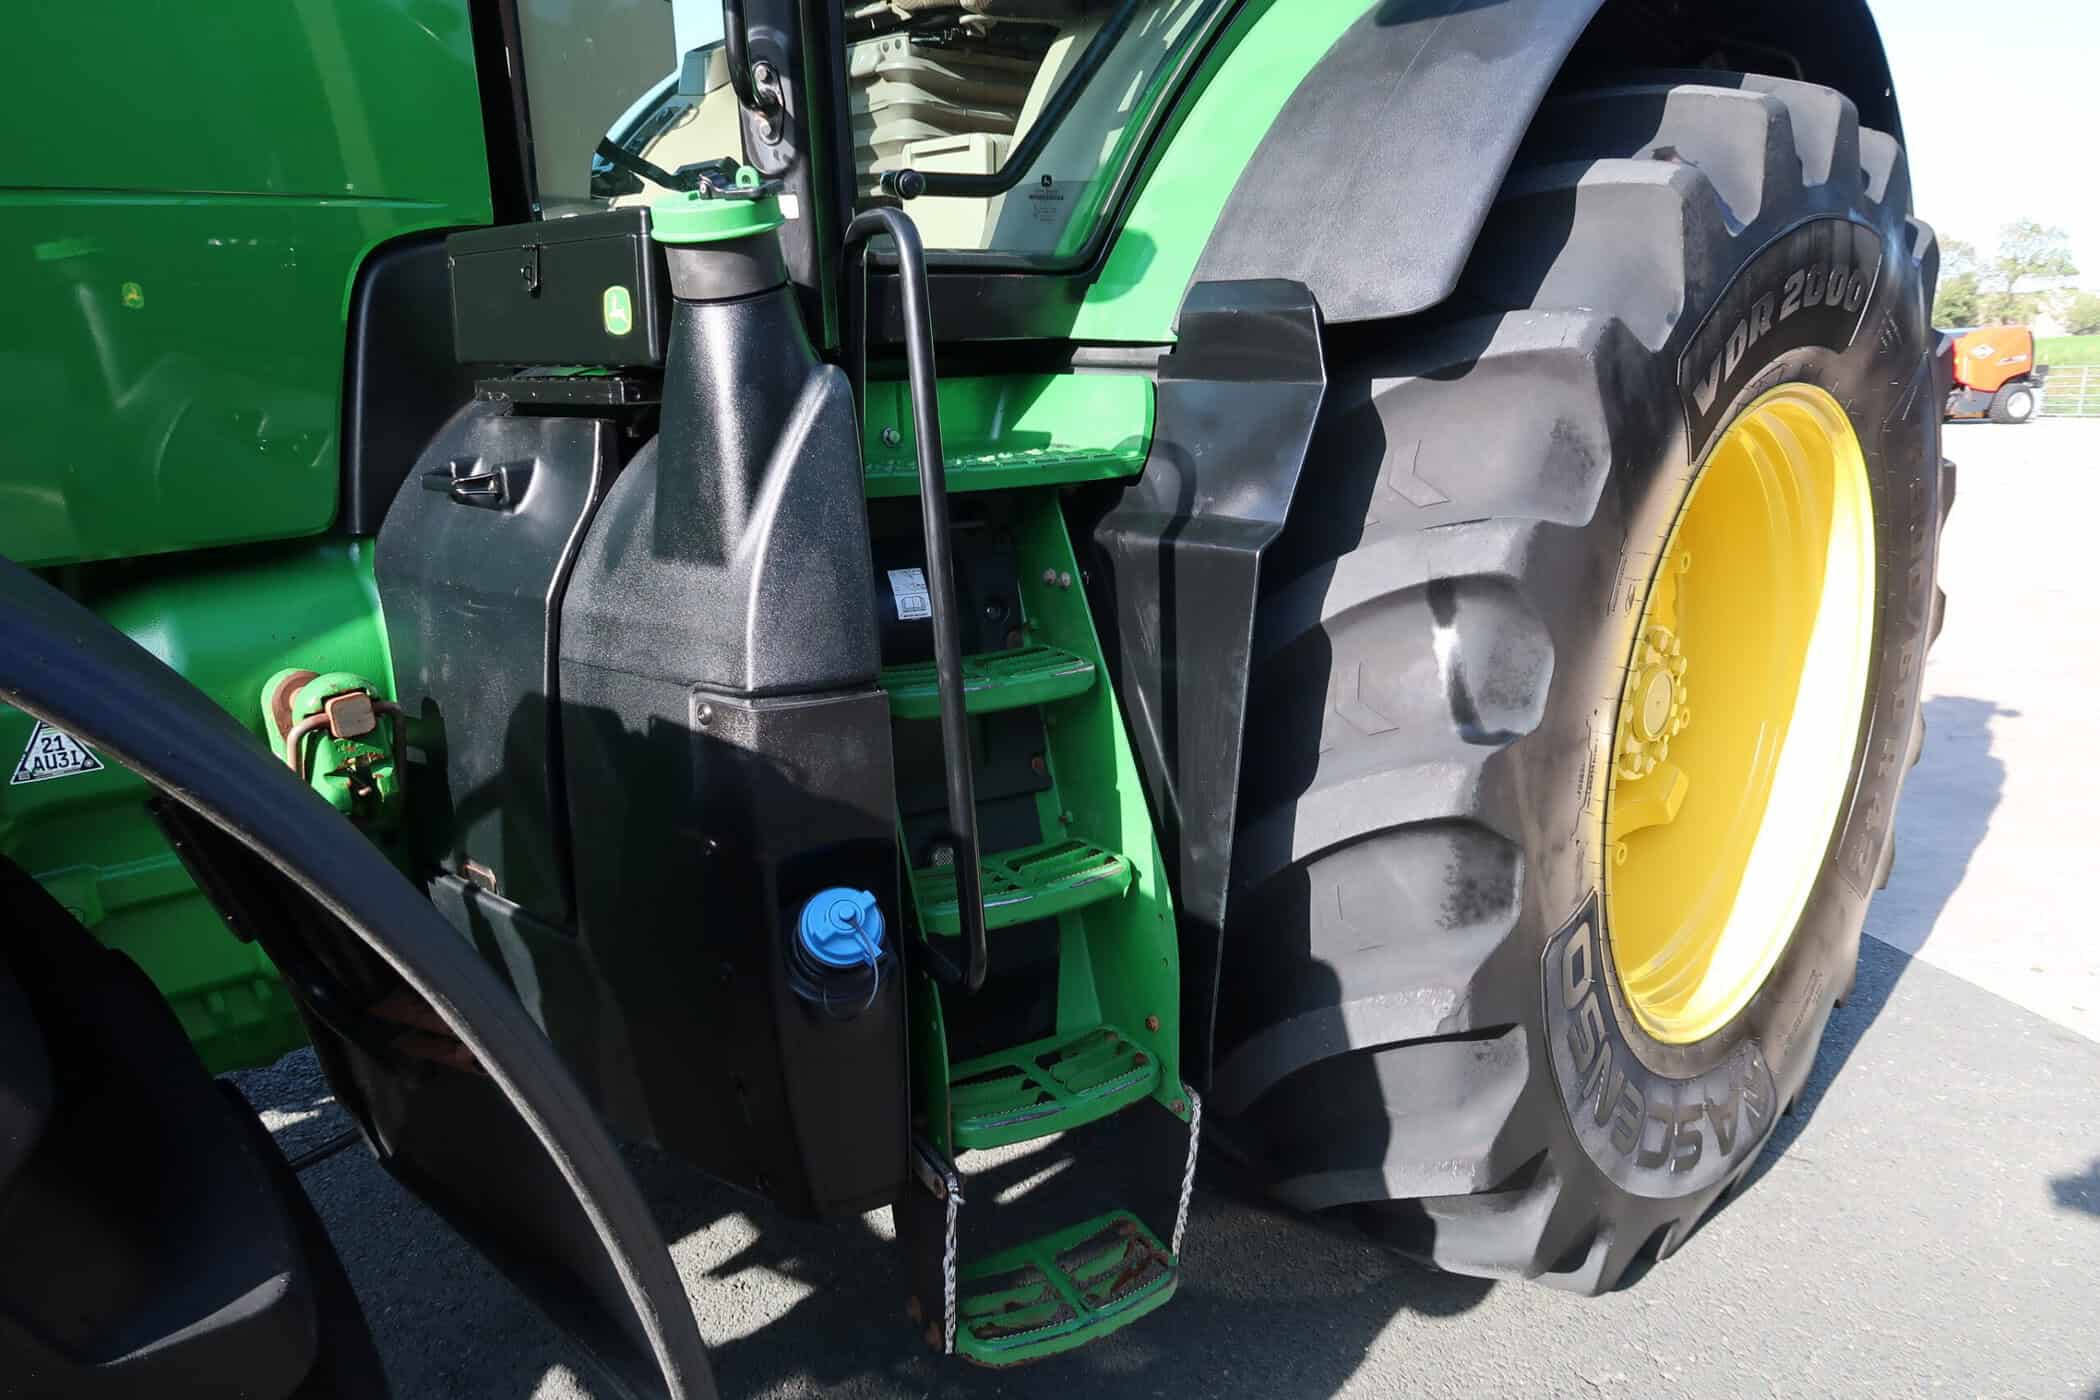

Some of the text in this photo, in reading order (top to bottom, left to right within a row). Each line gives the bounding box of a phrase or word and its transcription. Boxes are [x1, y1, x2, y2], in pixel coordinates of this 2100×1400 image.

[1692, 263, 1870, 416] VDR 2000
[41, 735, 65, 753] 21
[1562, 921, 1741, 1173] ASCENSO
